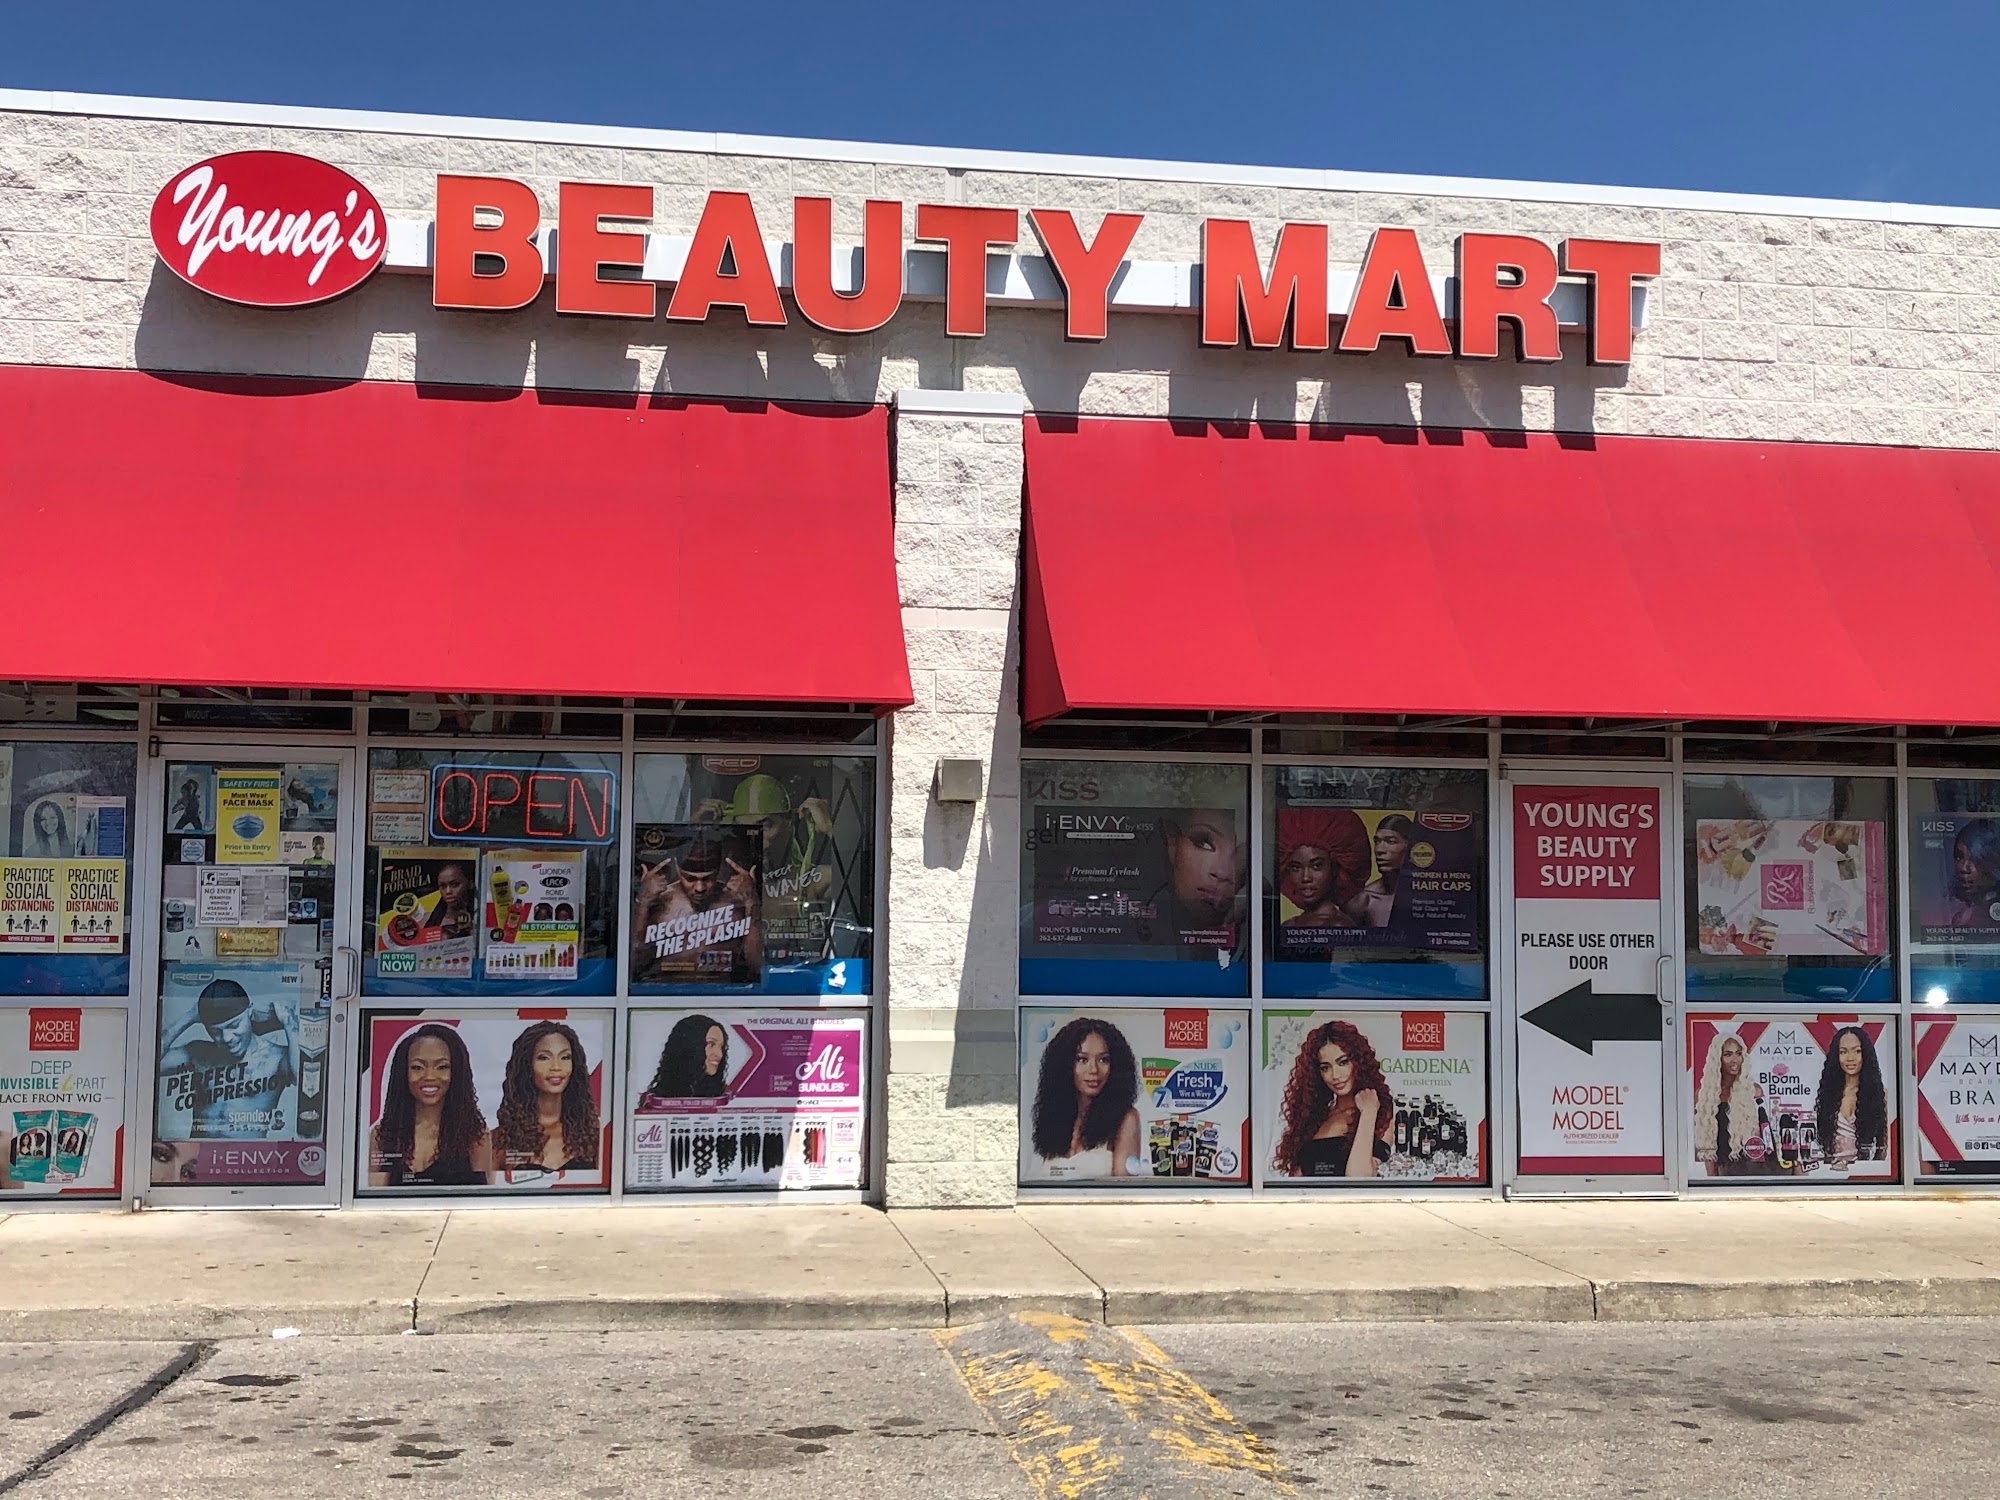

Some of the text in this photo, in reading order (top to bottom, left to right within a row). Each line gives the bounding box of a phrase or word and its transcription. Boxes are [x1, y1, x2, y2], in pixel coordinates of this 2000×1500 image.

[174, 165, 380, 287] Young's
[433, 174, 1661, 365] BEAUTY MART
[223, 780, 275, 788] SAFETY FIRST
[1027, 779, 1100, 802] KISS
[223, 799, 274, 807] FACE MASK
[437, 771, 610, 838] OPEN
[1421, 813, 1470, 823] RED
[1523, 802, 1655, 829] YOUNG'S
[1922, 821, 1955, 832] KISS
[1537, 836, 1637, 858] BEAUTY
[3, 867, 55, 882] PRACTICE
[68, 868, 119, 883] PRACTICE
[390, 864, 422, 882] BRAID
[1071, 867, 1108, 876] Premium
[1411, 871, 1441, 879] WOMEN
[1540, 865, 1636, 887] SUPPLY
[383, 873, 432, 895] FORMULA
[545, 878, 564, 887] LACE
[765, 867, 823, 899] WAVES
[1411, 880, 1472, 892] HAIR CAPS
[6, 882, 51, 899] SOCIAL
[70, 883, 116, 900] SOCIAL
[1, 899, 54, 912] DISTANCING
[66, 900, 119, 912] DISTANCING
[645, 904, 735, 944] RECOGNIZE
[1039, 926, 1071, 934] YOUNG'S
[655, 916, 751, 959] THE SPLASH!
[1521, 933, 1655, 949] PLEASE USE OTHER
[382, 961, 415, 972] NOW
[1569, 955, 1608, 970] DOOR
[35, 1020, 75, 1031] MODEL
[1169, 1021, 1204, 1031] MODEL
[1406, 1022, 1440, 1033] MODEL
[34, 1031, 75, 1042] MODEL
[1168, 1031, 1204, 1041] MODEL
[1406, 1033, 1441, 1043] MODEL
[1759, 1046, 1814, 1055] MAYDE
[31, 1060, 72, 1075] DEEP
[795, 1044, 846, 1081] Ali
[1193, 1062, 1218, 1070] NUDE
[1380, 1058, 1471, 1074] GARDENIA
[0, 1077, 59, 1090] NVISIBLE
[1759, 1072, 1800, 1084] Bloom
[798, 1082, 845, 1093] BUNDLES
[1178, 1089, 1191, 1098] Wet
[1768, 1084, 1811, 1096] Bundle
[32, 1094, 73, 1103] FRONT
[76, 1094, 102, 1103] WIG
[1153, 1091, 1167, 1108] 7
[228, 1109, 271, 1124] spandex
[1552, 1110, 1625, 1131] MODEL
[637, 1124, 663, 1143] Ali
[1563, 1132, 1620, 1140] AUTHORIZED DEALER
[303, 1151, 320, 1162] 3D
